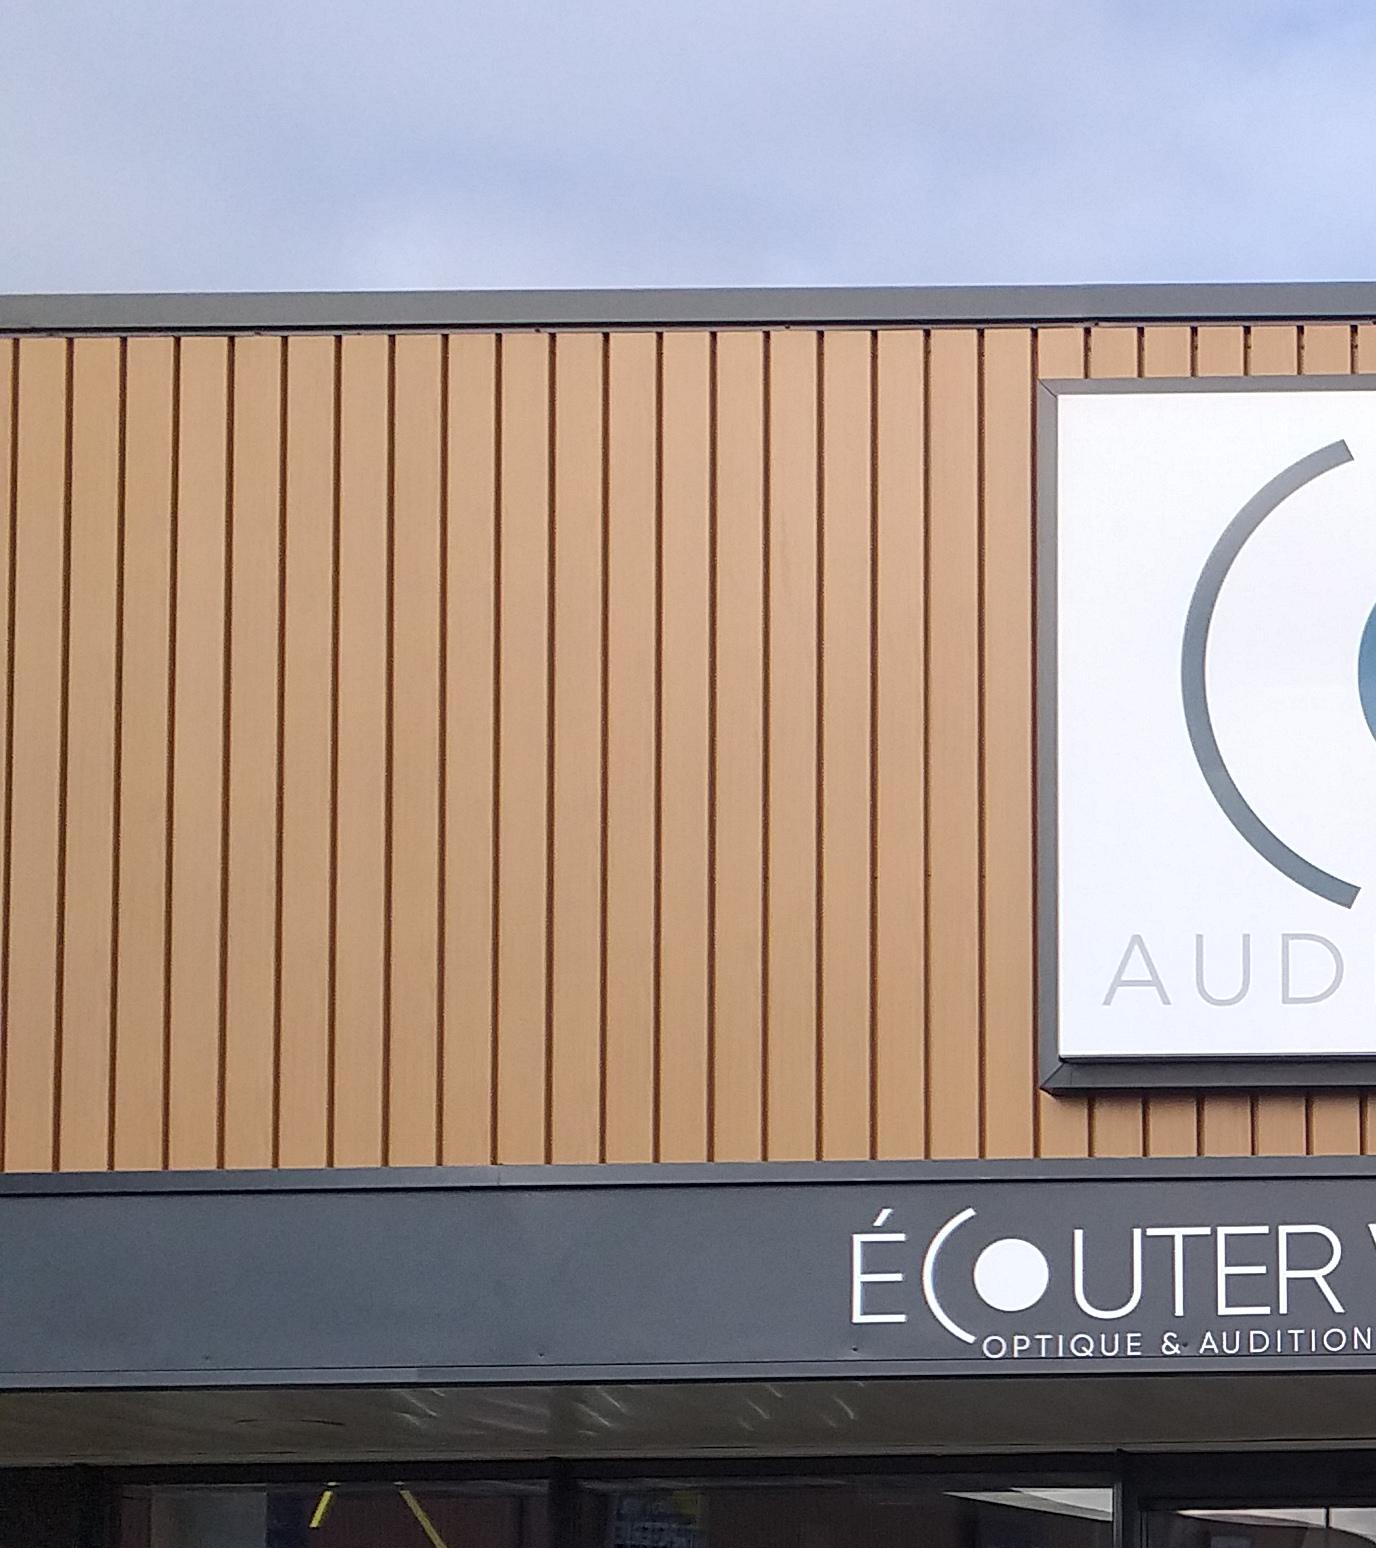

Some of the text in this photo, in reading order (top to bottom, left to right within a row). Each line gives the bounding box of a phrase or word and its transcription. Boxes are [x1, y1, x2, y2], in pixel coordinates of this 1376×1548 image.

[851, 1206, 1345, 1344] ÉCOUTER
[982, 1331, 1143, 1359] OPTIQUE
[1160, 1332, 1183, 1355] &
[1199, 1326, 1373, 1354] AUDITION
